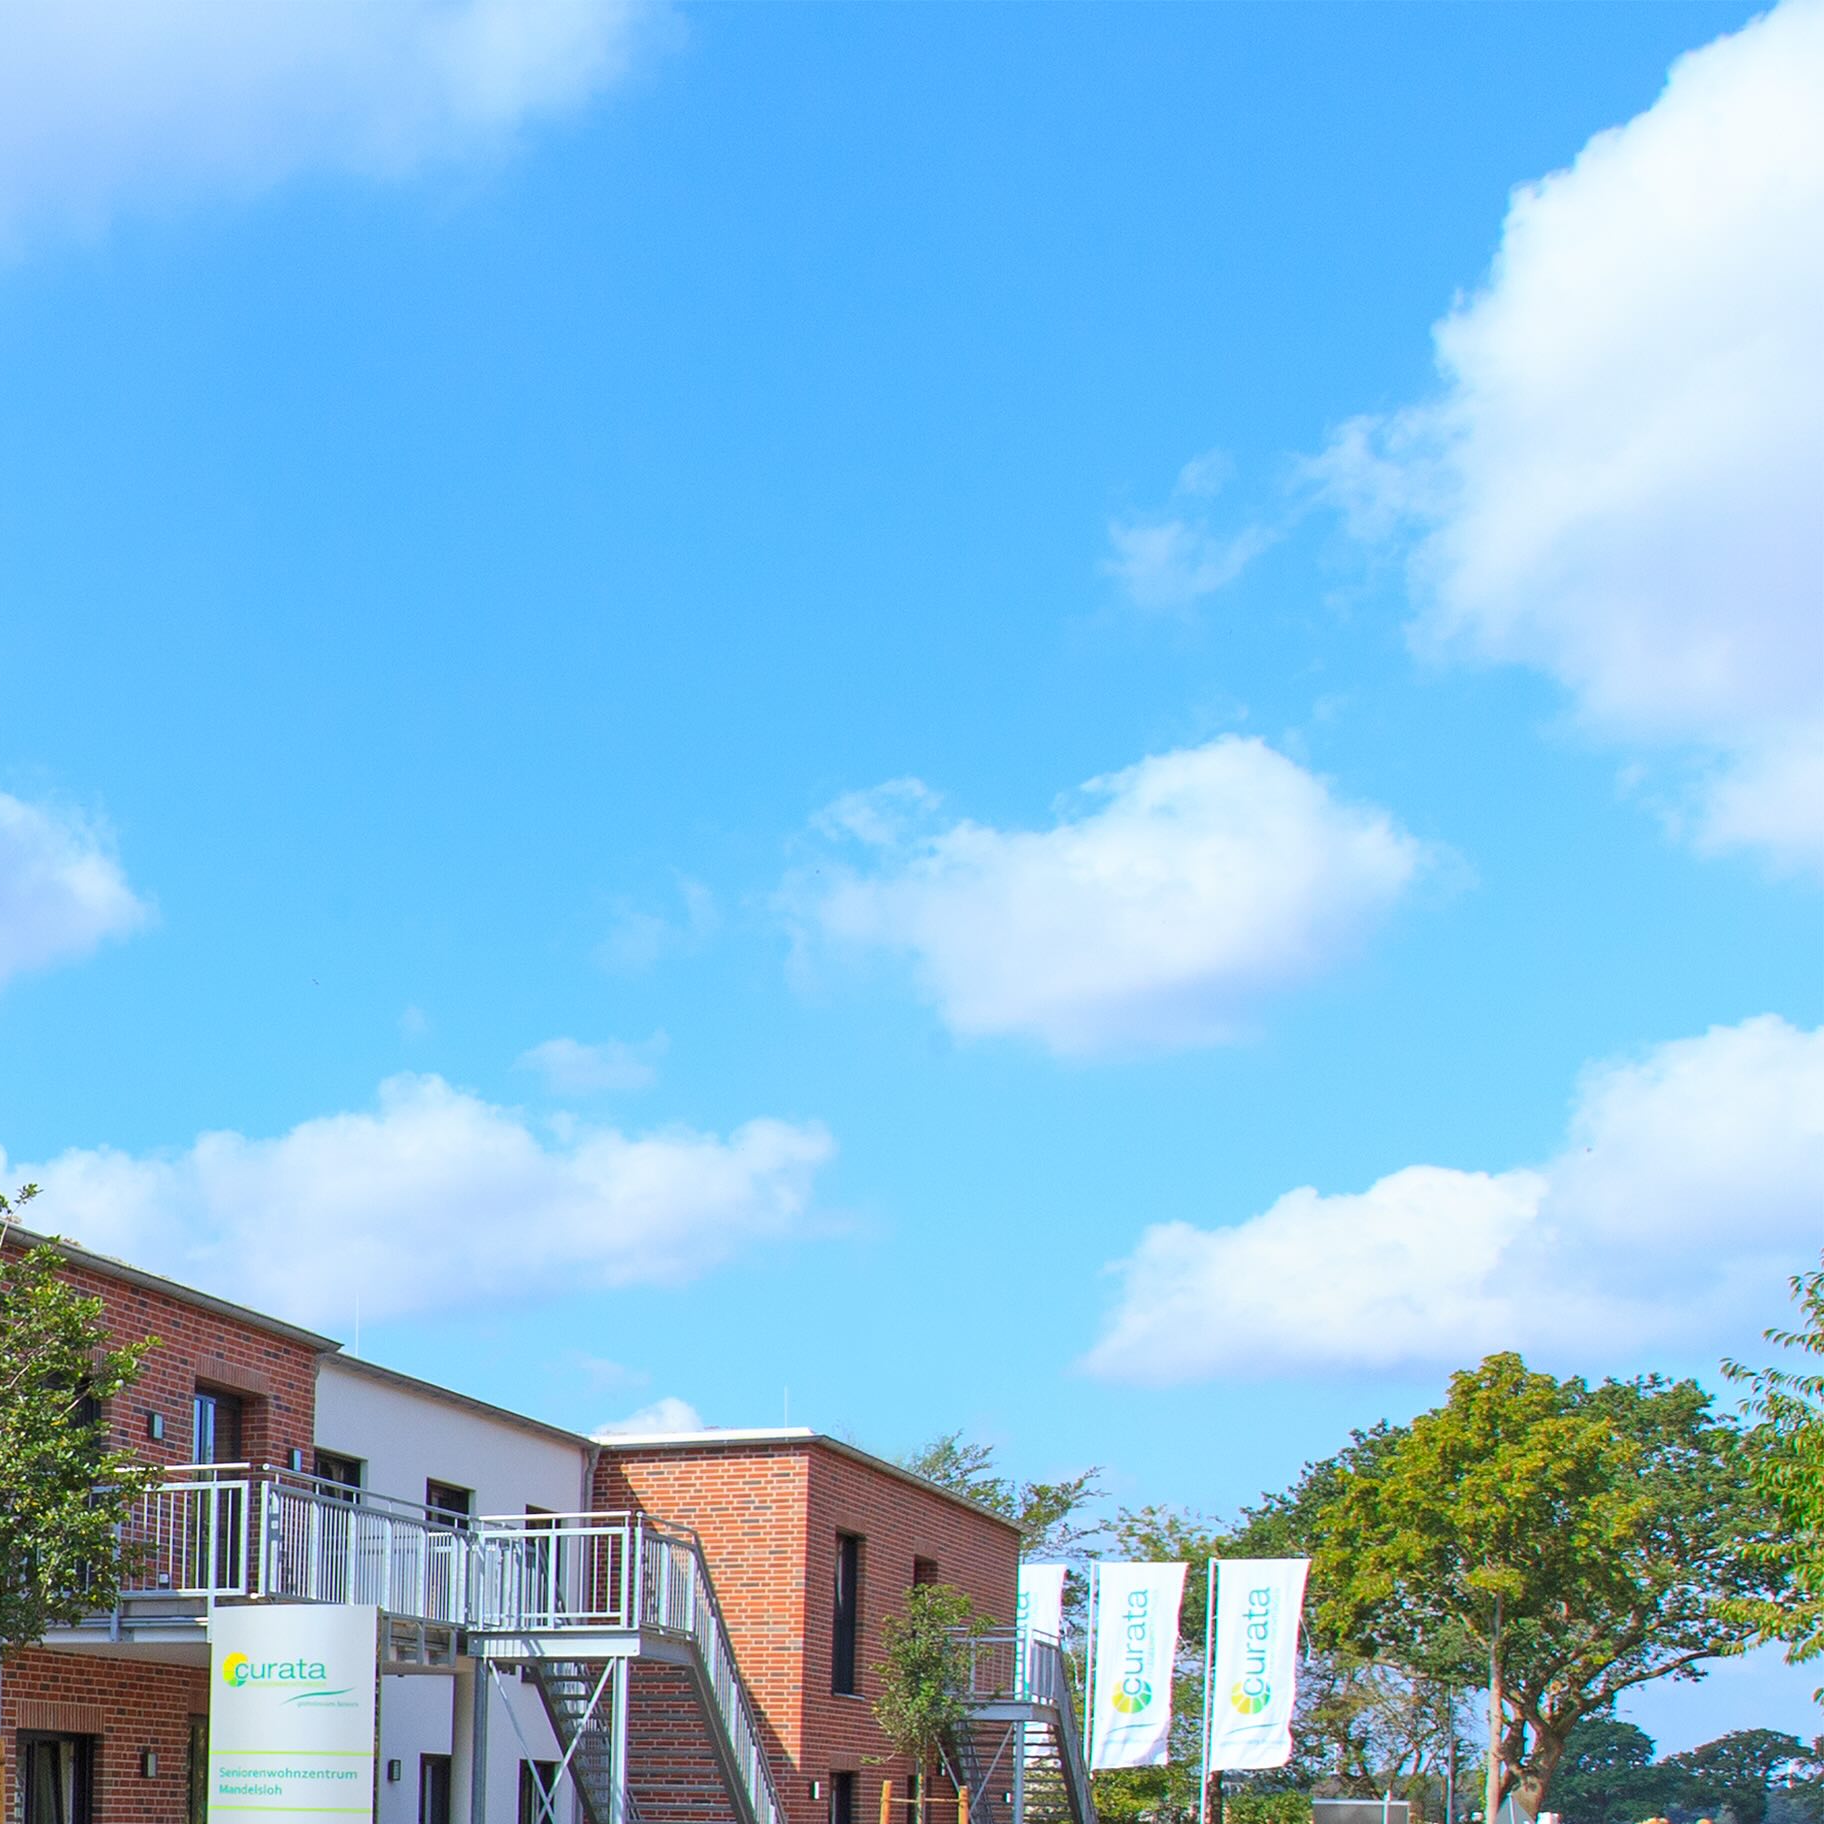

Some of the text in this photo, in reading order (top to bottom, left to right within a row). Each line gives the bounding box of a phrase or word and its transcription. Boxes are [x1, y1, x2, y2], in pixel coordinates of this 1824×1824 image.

[234, 1658, 327, 1680] curata
[1122, 1589, 1149, 1696] curata
[1242, 1586, 1271, 1697] curata
[218, 1766, 358, 1780] Seniorenwohnzentrum
